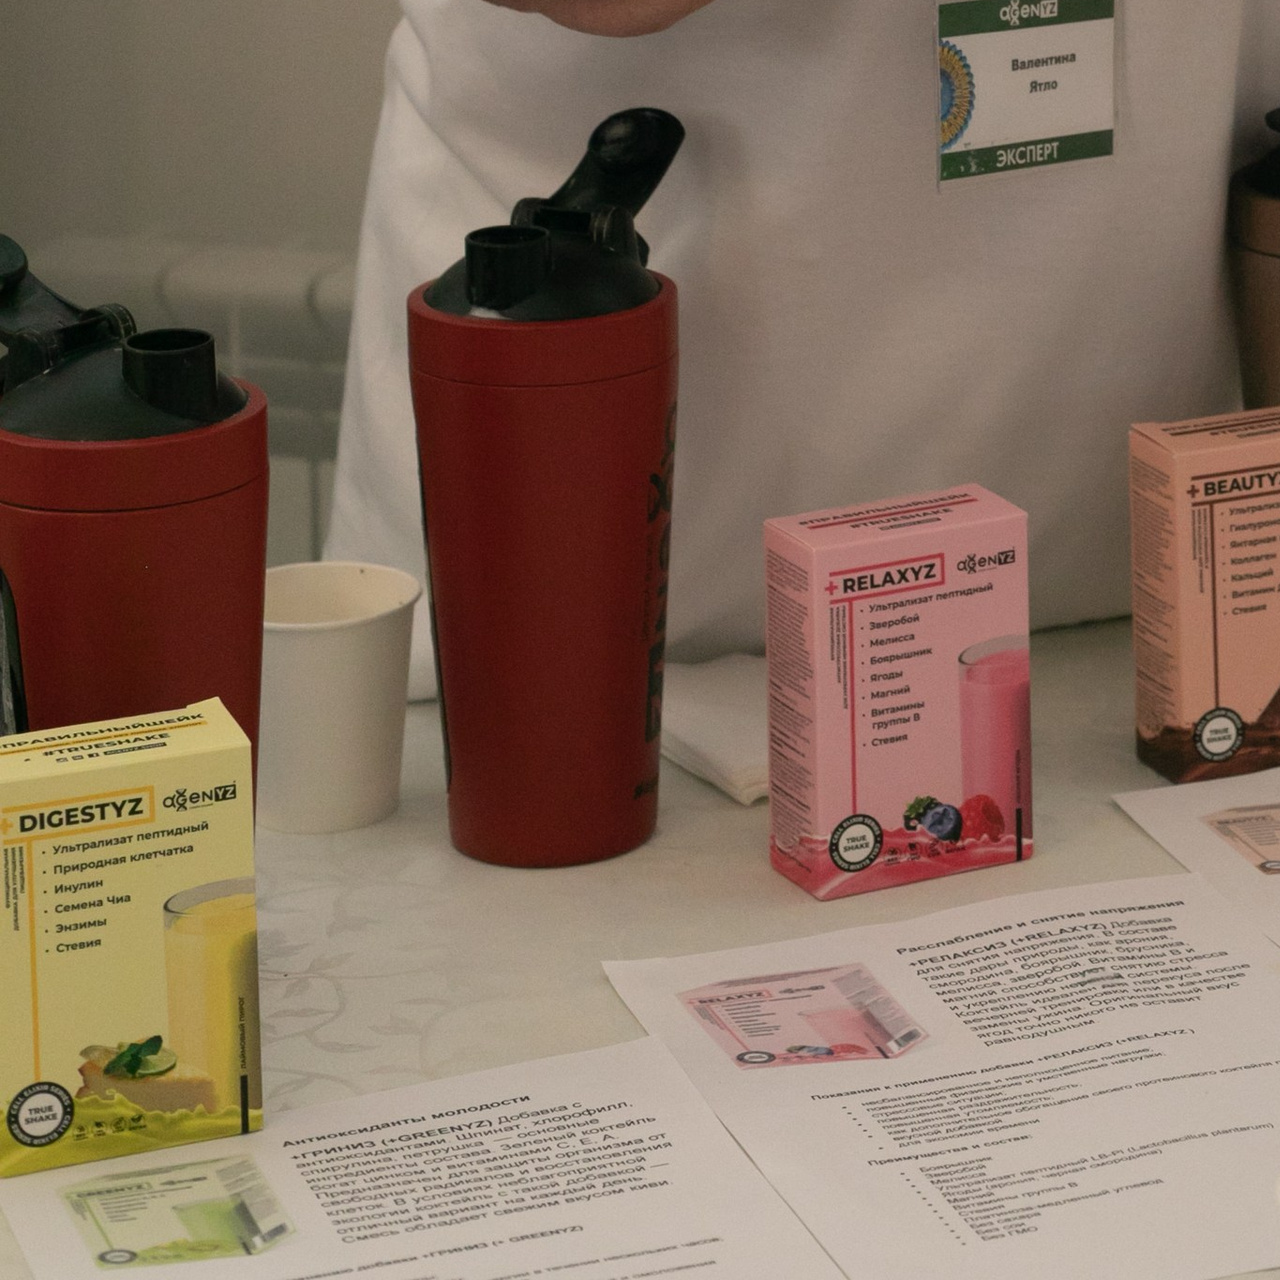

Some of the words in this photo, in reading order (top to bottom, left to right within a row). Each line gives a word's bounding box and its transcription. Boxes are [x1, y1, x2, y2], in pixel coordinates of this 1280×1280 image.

[1011, 53, 1076, 71] Валентина
[1029, 79, 1058, 93] Ятло
[996, 142, 1059, 167] ЭКСПЕРТ
[1230, 553, 1277, 565] Коллаген
[843, 563, 936, 594] RELAXYZ
[869, 596, 933, 613] Ультрализат
[936, 583, 993, 601] пептидный
[1232, 586, 1275, 599] Витамин
[1232, 603, 1267, 615] Стевия
[869, 614, 919, 630] Зверобой
[870, 634, 915, 648] Мелисса
[870, 648, 932, 665] Боярышник
[870, 671, 903, 683] Ягоды
[871, 685, 911, 700] Магний
[871, 701, 925, 718] Витамины
[0, 713, 204, 750] ПРАВИЛЬНЫЙШЕЙК
[872, 716, 911, 730] группы
[43, 732, 171, 757] #TRUESHAKE
[872, 734, 908, 747] Стевия
[19, 797, 143, 833] DIGESTYZ
[52, 834, 133, 855] Ультрализат
[136, 821, 209, 842] пептидный
[846, 835, 867, 844] TRUE
[843, 842, 870, 853] SHAKE
[54, 856, 127, 876] Природная
[130, 844, 194, 862] клетчатка
[54, 879, 104, 895] Инулин
[55, 900, 103, 914] Семена
[107, 894, 132, 906] Чиа
[55, 919, 107, 934] Энзимы
[896, 925, 1011, 954] Расслабление
[1030, 912, 1085, 924] снятие
[1089, 900, 1184, 915] напряжения
[56, 939, 102, 953] Стевия
[909, 941, 1006, 966] +РЕЛАКСИЗ
[1010, 923, 1106, 945] (+RELAXYZ)
[1110, 917, 1172, 928] Добавка
[916, 965, 944, 975] для
[948, 953, 999, 968] снятия
[1003, 933, 1094, 955] напряжения.
[1118, 925, 1176, 935] составе
[921, 971, 964, 981] такие
[969, 960, 1008, 973] дары
[1012, 944, 1083, 962] природы,
[1115, 934, 1172, 944] арония,
[929, 969, 1017, 988] смородина,
[1020, 949, 1111, 970] боярышник,
[1115, 941, 1188, 952] брусника,
[942, 990, 997, 1003] магний
[1001, 966, 1105, 992] способствуют
[1110, 961, 1165, 970] снятию
[1169, 951, 1228, 963] стресса
[24, 1113, 58, 1125] SHAKE
[28, 1105, 54, 1116] TRUE
[283, 1116, 425, 1147] Антиоксиданты
[431, 1095, 529, 1118] молодости
[292, 1140, 375, 1159] +ГРИНИЗ
[381, 1119, 492, 1145] (+GREENYZ)
[498, 1105, 567, 1124] Добавка
[309, 1180, 355, 1194] богат
[363, 1169, 425, 1182] цинком
[446, 1146, 551, 1169] витаминами
[315, 1176, 441, 1199] Предназначен
[448, 1169, 478, 1179] для
[485, 1155, 550, 1171] защиты
[555, 1138, 643, 1158] организма
